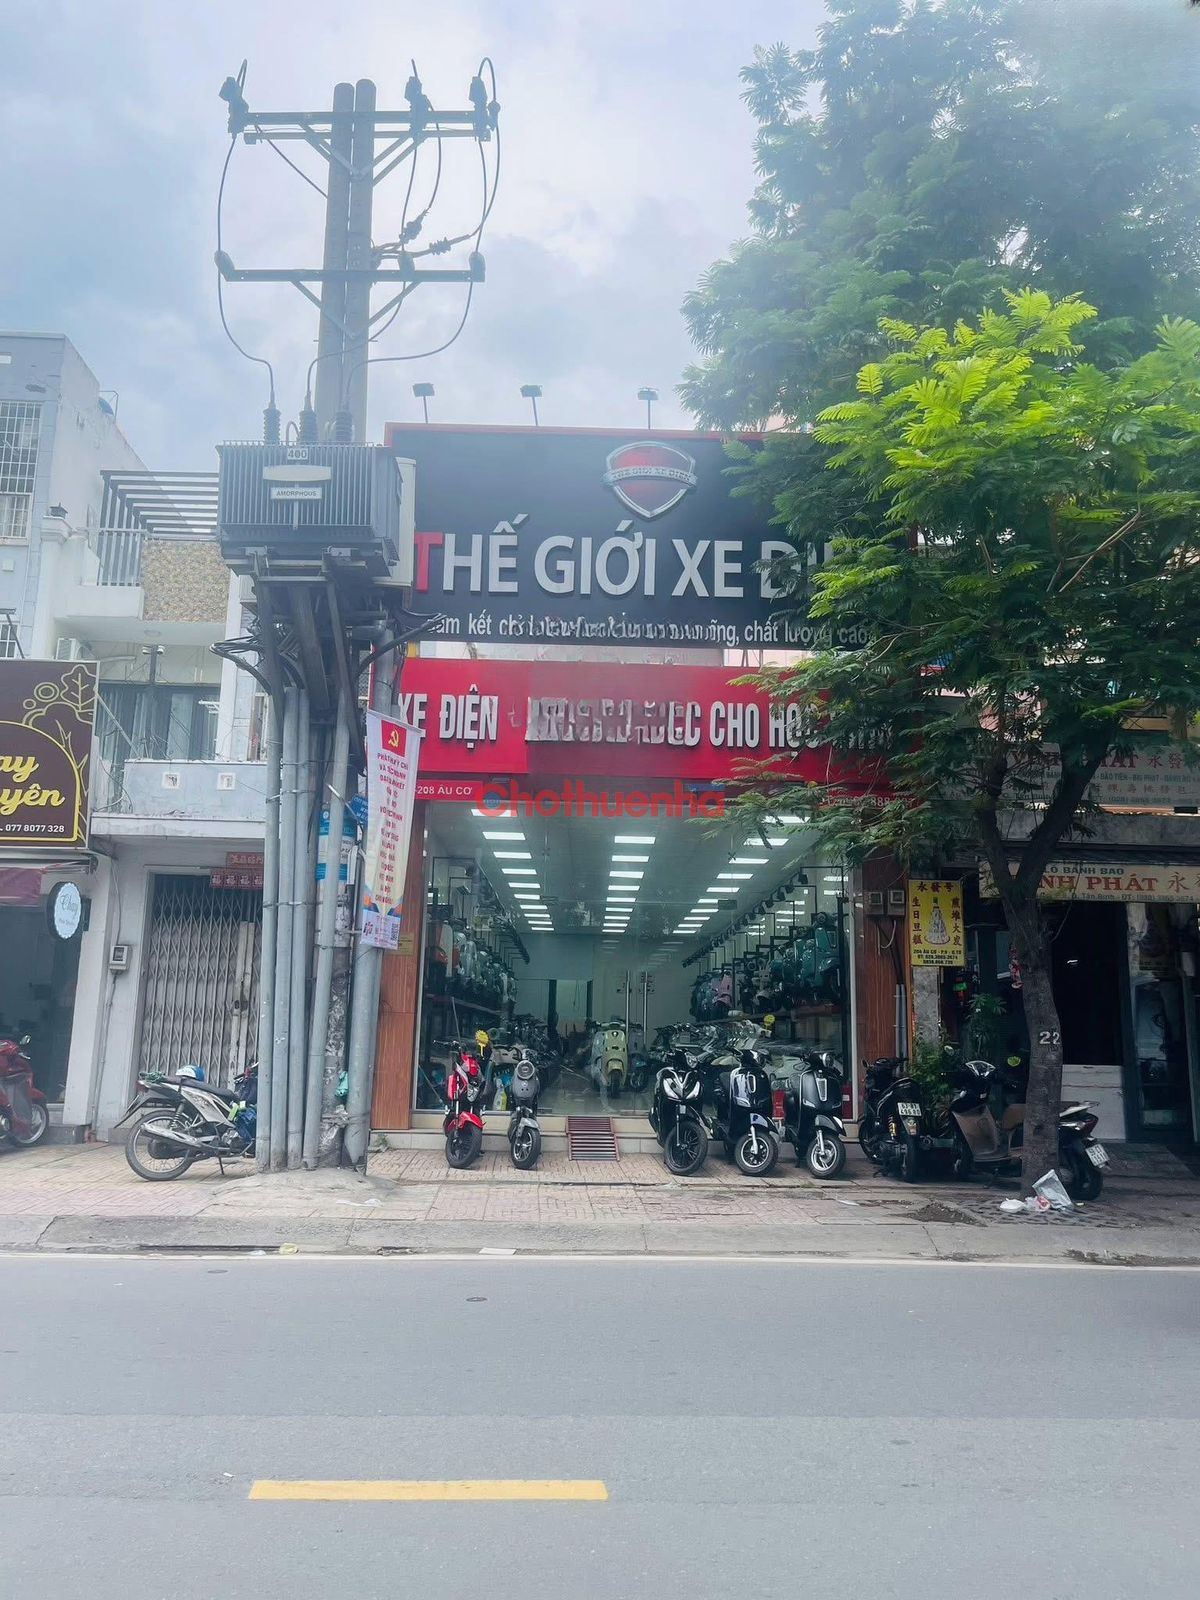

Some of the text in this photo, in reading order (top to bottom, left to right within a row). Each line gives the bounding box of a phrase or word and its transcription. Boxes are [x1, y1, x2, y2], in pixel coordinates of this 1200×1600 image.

[414, 513, 531, 594] THẾ
[534, 519, 655, 598] GIỚI
[671, 538, 743, 599] XE
[427, 616, 461, 635] am
[468, 608, 492, 636] kết
[744, 618, 779, 644] chất
[397, 692, 428, 739] XE
[438, 683, 499, 750] ĐIỆN
[709, 700, 761, 749] CHO
[417, 784, 473, 796] 208 ÂU CƠ
[5, 824, 65, 834] 077 8077 328
[1086, 872, 1159, 892] PHÁT
[1039, 1030, 1061, 1045] 22
